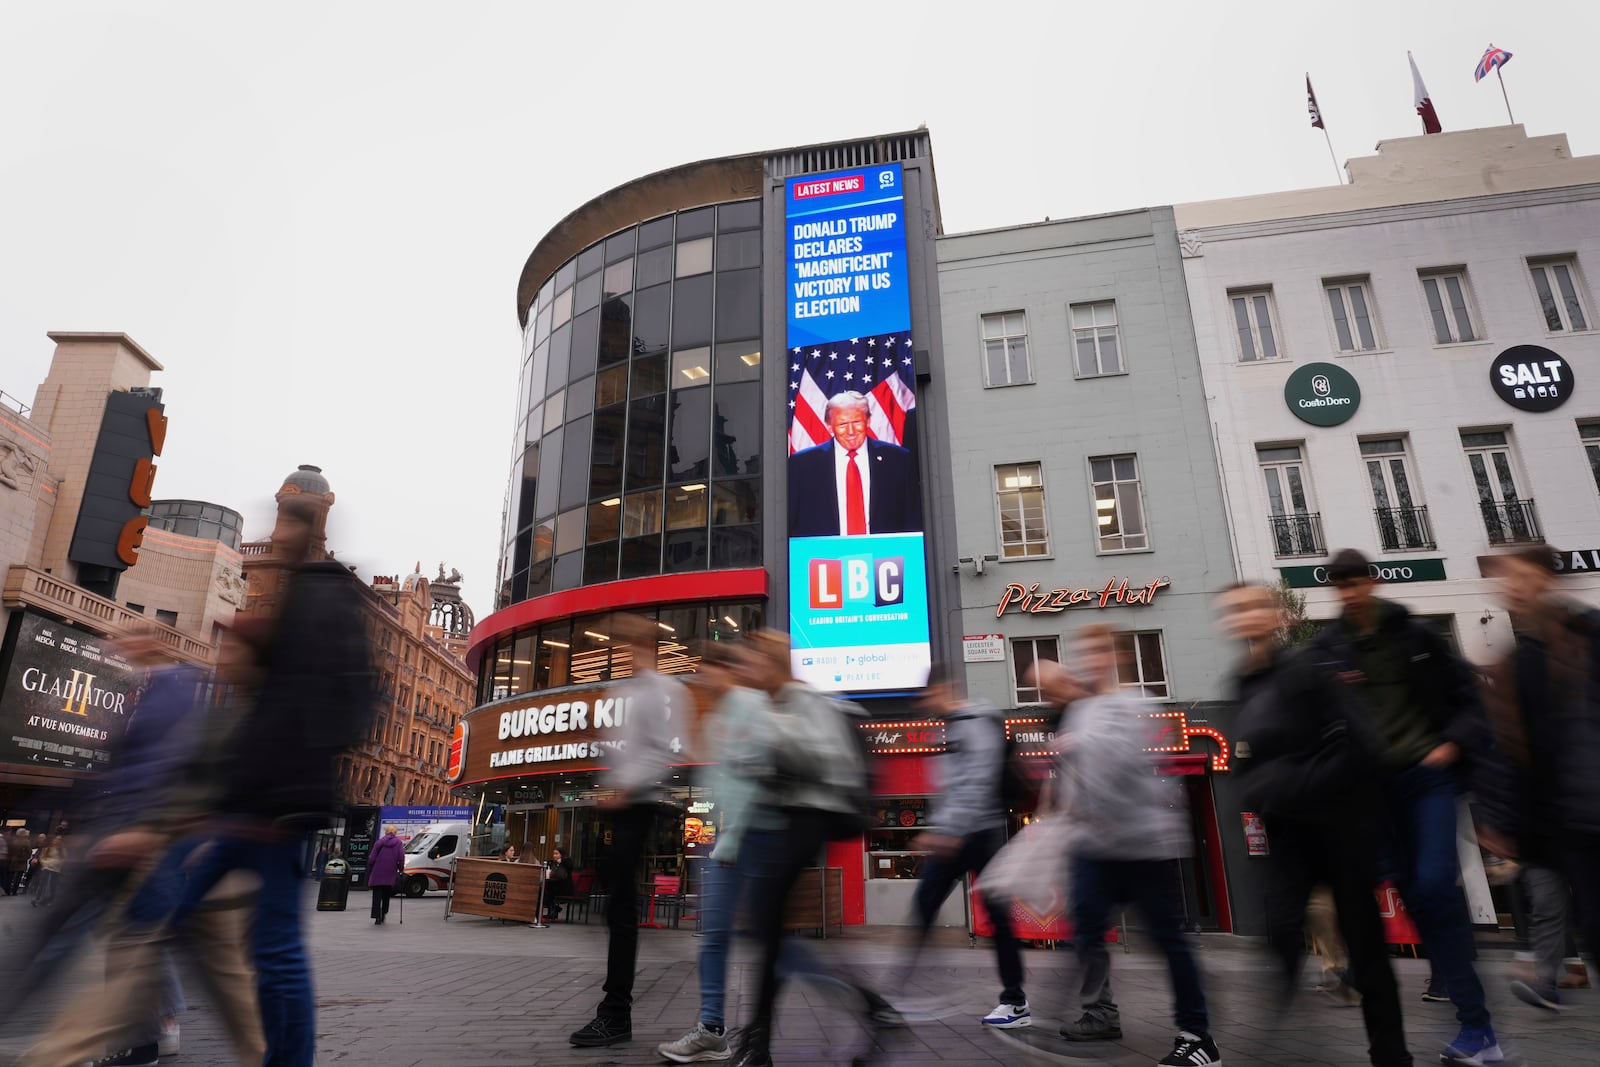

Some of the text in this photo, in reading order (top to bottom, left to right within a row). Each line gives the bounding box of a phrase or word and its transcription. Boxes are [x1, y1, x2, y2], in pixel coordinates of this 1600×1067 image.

[797, 178, 859, 196] LATEST NEWS
[794, 213, 897, 240] DONALD TRUMP
[794, 236, 863, 259] DECLARES
[795, 252, 893, 278] 'MAGNIFICENT'
[794, 272, 891, 298] VICTORY IN US
[795, 296, 860, 318] ELECTION
[1499, 360, 1562, 387] SALT
[1299, 397, 1351, 408] Costo Doro
[1368, 563, 1413, 580] Doro
[818, 559, 900, 603] LBC
[996, 576, 1171, 618] Pizza Hut
[809, 612, 908, 625] LEADING BRITAIN'S CONVERSATION
[35, 635, 55, 647] MESCAL
[60, 643, 78, 655] PASCAL
[966, 641, 994, 649] LEICESTER
[82, 649, 101, 661] NIELSEN
[858, 654, 887, 666] global
[22, 667, 125, 714] GLADIATOR
[28, 715, 107, 741] AT VUE NOVEMBER 15
[498, 700, 588, 740] BURGER
[874, 731, 902, 745] Hut
[1015, 732, 1046, 743] COME
[490, 748, 525, 768] FLAME
[525, 742, 588, 763] GRILLING
[483, 888, 506, 899] KING
[484, 880, 507, 890] BURGER
